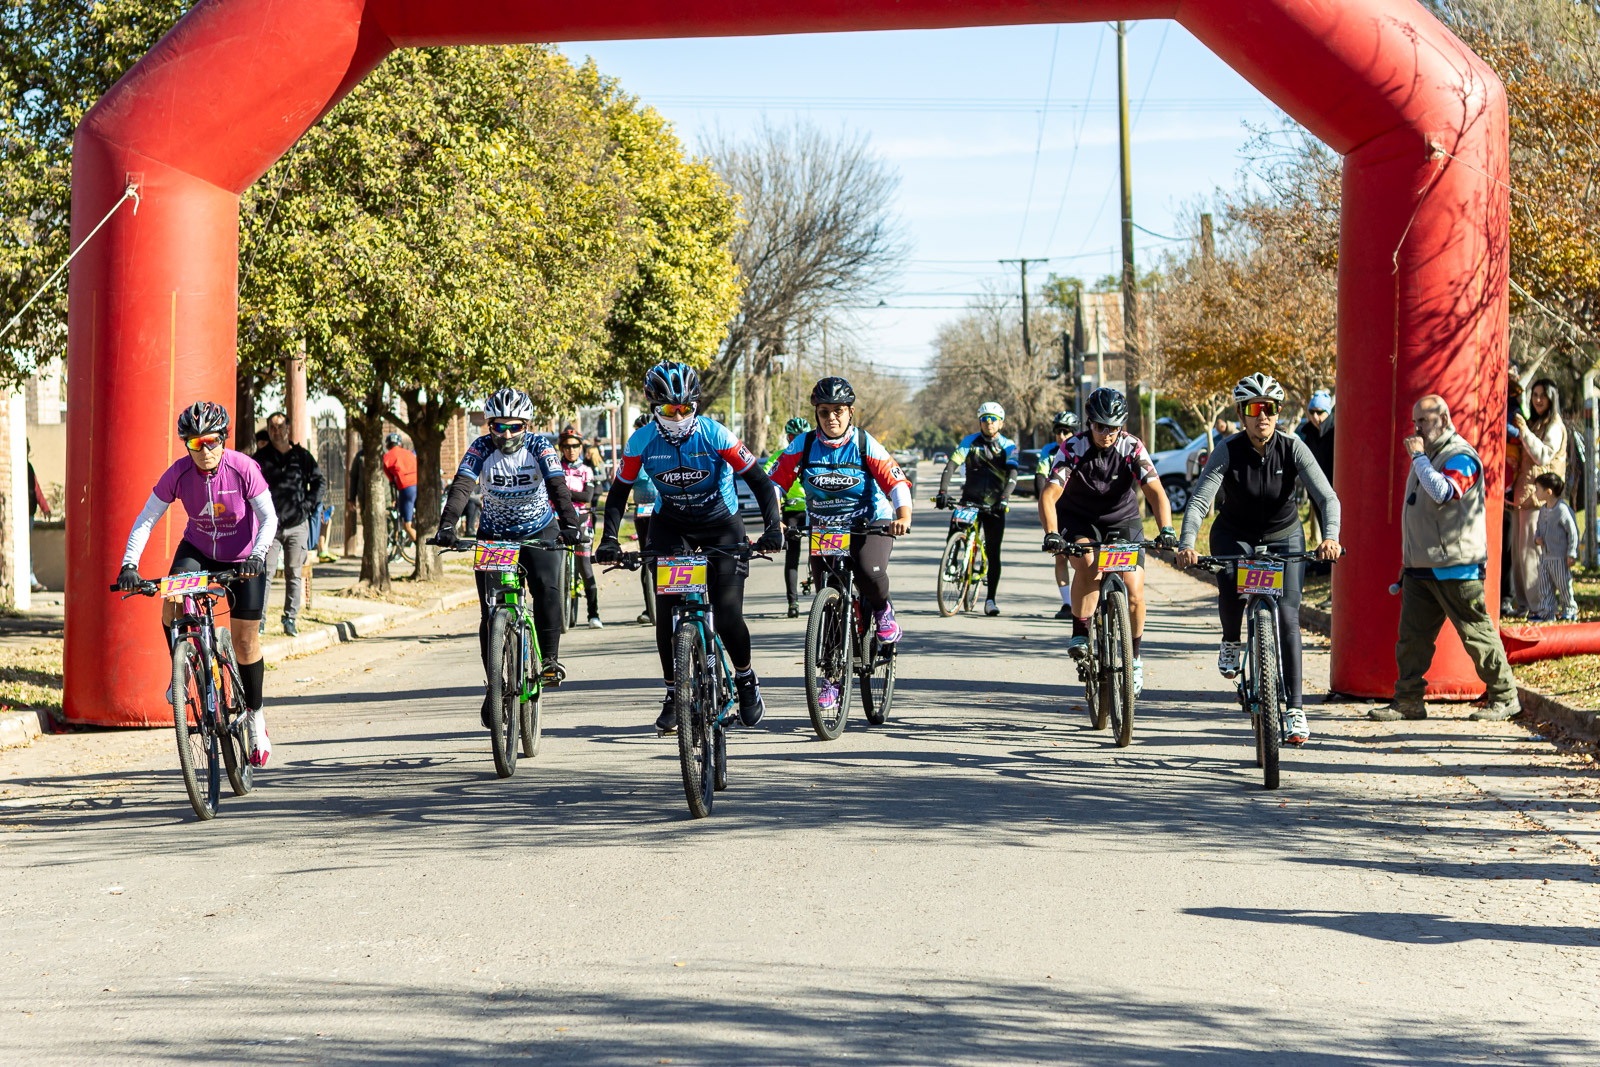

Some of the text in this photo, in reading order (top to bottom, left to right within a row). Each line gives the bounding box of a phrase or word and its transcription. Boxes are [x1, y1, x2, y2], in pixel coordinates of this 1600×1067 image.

[662, 470, 703, 482] MOBKECO
[198, 500, 226, 518] AP
[818, 533, 844, 549] 46
[1105, 552, 1132, 566] 115
[668, 566, 694, 585] 15
[1244, 570, 1276, 587] 86
[167, 577, 201, 592] 139
